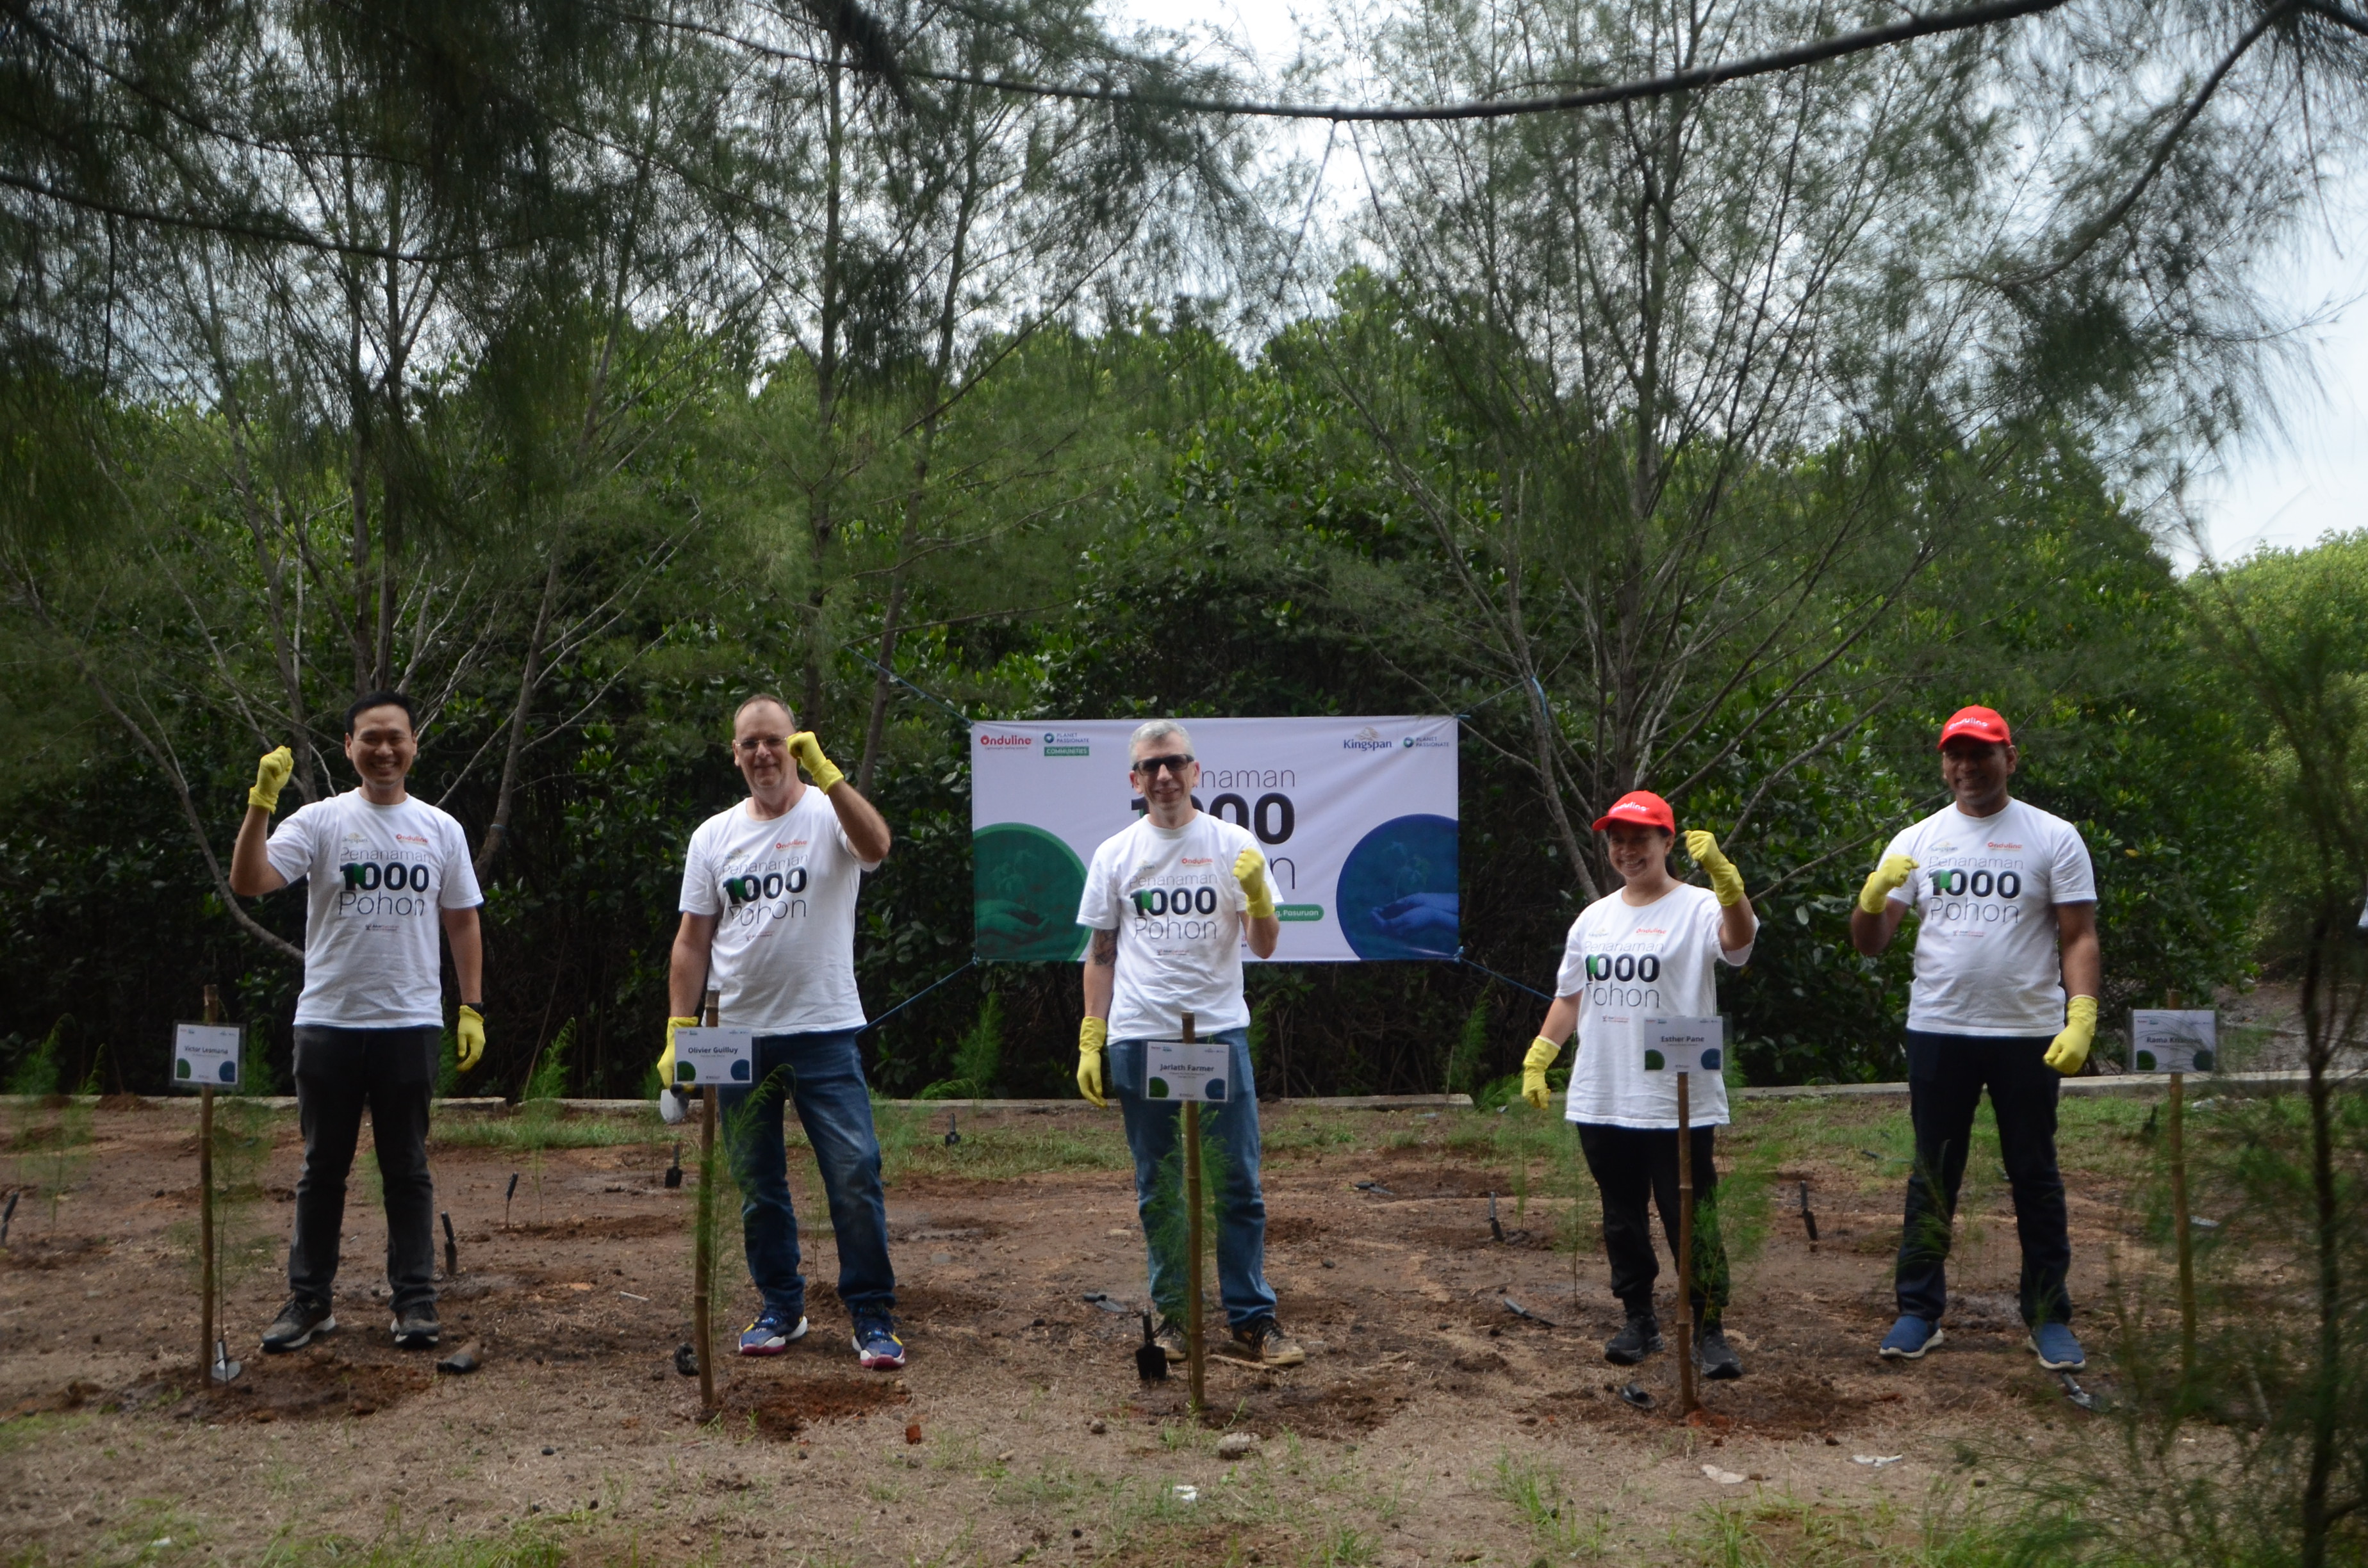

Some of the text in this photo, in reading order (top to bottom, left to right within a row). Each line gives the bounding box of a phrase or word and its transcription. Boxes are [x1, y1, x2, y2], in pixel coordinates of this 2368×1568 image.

[980, 735, 1032, 745] Onduline
[1344, 739, 1392, 751] Kingspan
[1131, 769, 1295, 788] naman
[340, 847, 431, 862] Penanaman
[722, 854, 808, 875] Penanaman
[1928, 856, 2023, 869] Penanaman
[340, 862, 429, 892] 1000
[723, 865, 807, 904] 1000
[1129, 874, 1217, 888] Penanaman
[1928, 868, 2022, 899] 1000
[338, 891, 425, 916] Pohon
[1130, 886, 1217, 916] 1000
[1930, 897, 2019, 923] Pohon
[728, 899, 807, 926] Pohon
[1134, 916, 1217, 940] Pohon
[1584, 940, 1665, 952] Penanaman
